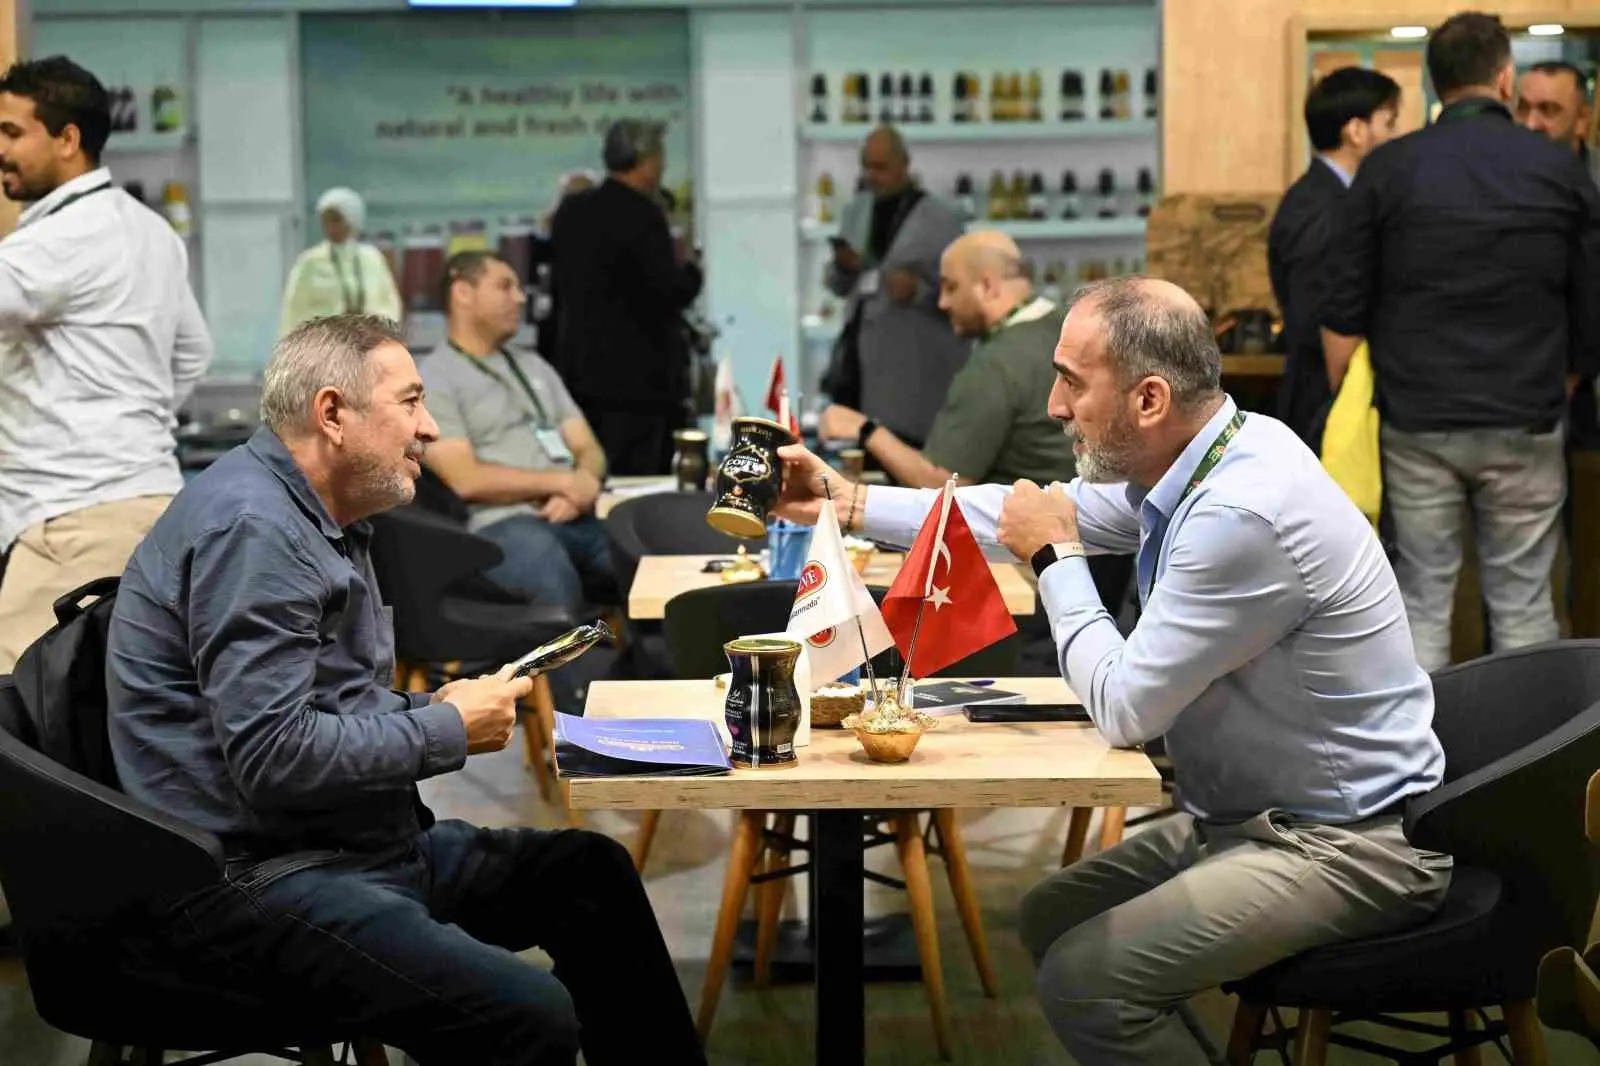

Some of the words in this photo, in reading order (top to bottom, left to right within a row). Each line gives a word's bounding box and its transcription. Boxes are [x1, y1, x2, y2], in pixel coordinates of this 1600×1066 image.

[479, 85, 573, 109] healthy
[582, 83, 618, 104] life
[375, 117, 465, 138] natural
[473, 116, 519, 137] and
